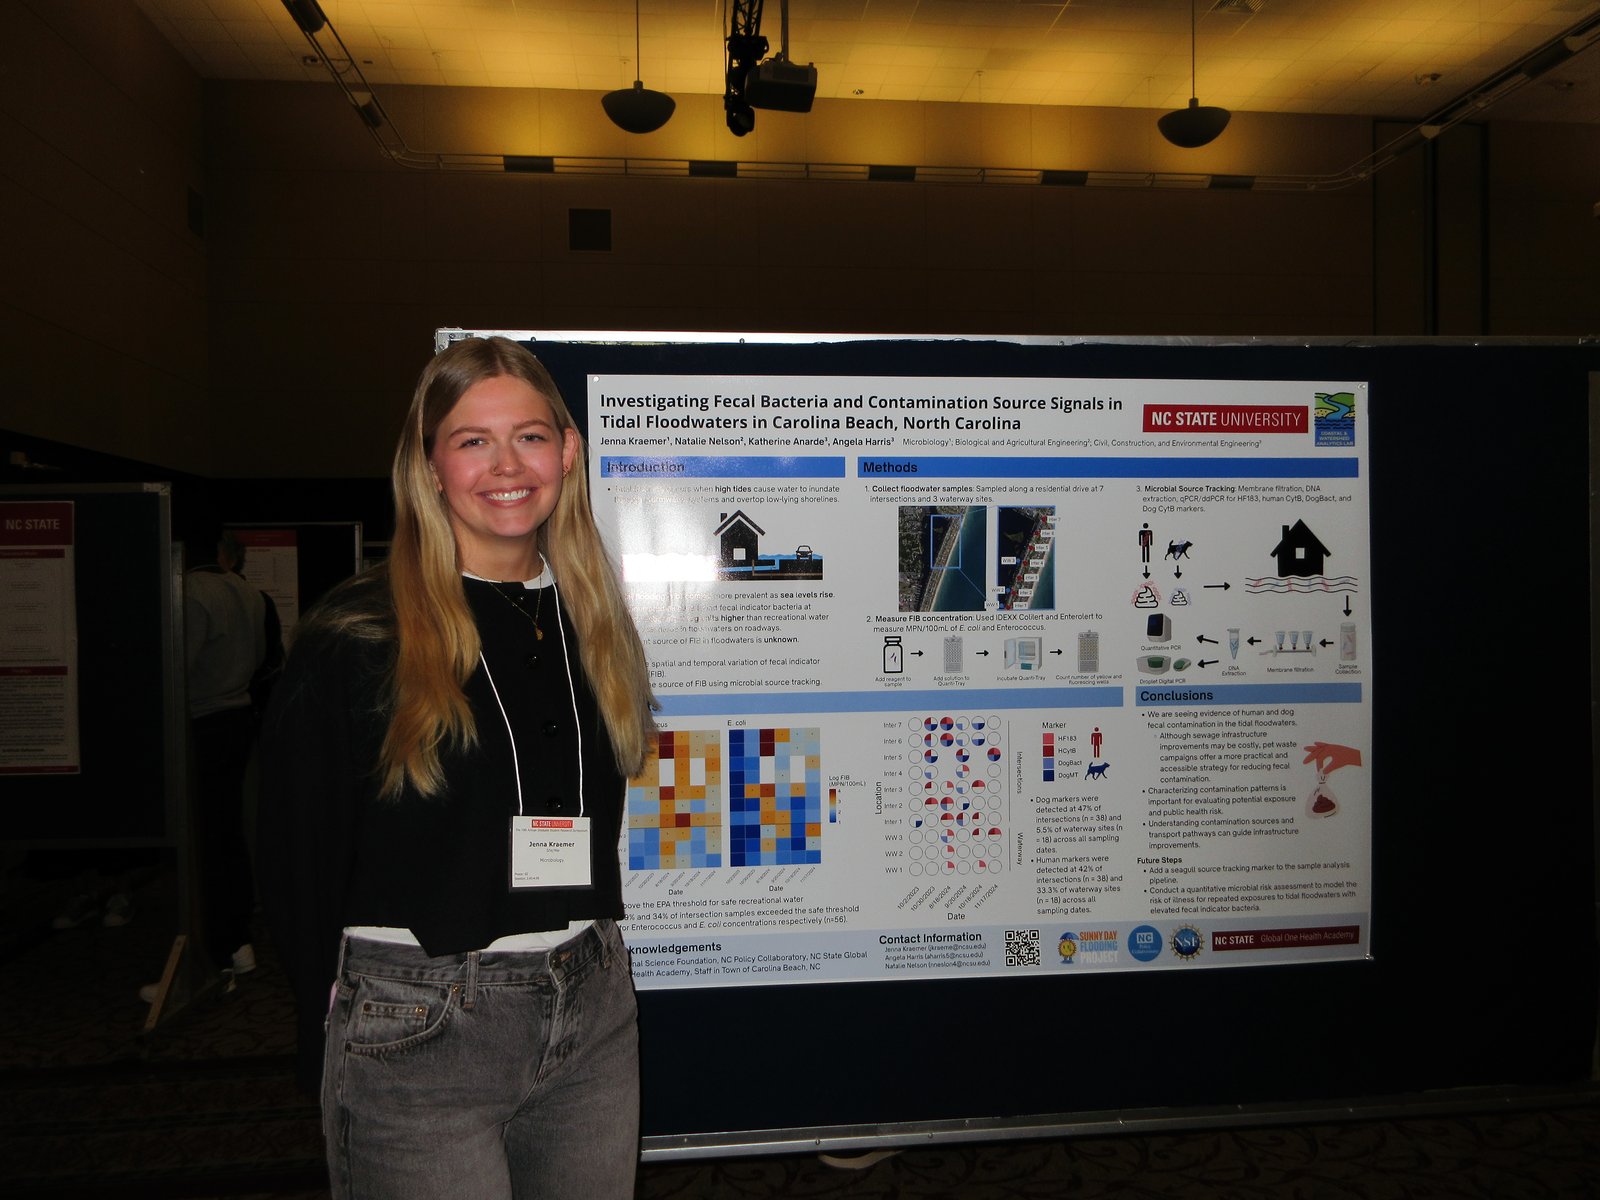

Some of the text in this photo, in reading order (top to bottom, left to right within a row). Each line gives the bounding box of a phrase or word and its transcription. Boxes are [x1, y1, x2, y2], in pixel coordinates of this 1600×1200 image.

[601, 394, 1122, 413] Investigating Fecal Bacteria and Contamination Source Signals in
[600, 415, 1020, 431] Tidal Floodwaters in Carolina Beach, North Carolina
[1152, 412, 1301, 426] NC STATE UNIVERSITY
[600, 437, 626, 445] Jenna
[675, 437, 706, 445] Natalie
[832, 438, 863, 447] Angela
[955, 439, 990, 447] Biological
[1006, 439, 1046, 447] Agricultural
[1111, 439, 1156, 447] Construction,
[605, 460, 686, 474] Introduction
[864, 462, 918, 472] Methods
[715, 485, 731, 494] high
[976, 485, 1007, 493] Sampled
[736, 496, 765, 504] overtop
[766, 496, 798, 504] low-lying
[940, 496, 974, 504] waterway
[1142, 505, 1157, 514] Dog
[1158, 505, 1175, 513] CytB
[6, 518, 60, 530] NC STATE
[734, 592, 768, 600] prevalent
[959, 624, 965, 632] E.
[1140, 690, 1214, 701] Conclusions
[1174, 710, 1198, 719] seeing
[1280, 709, 1294, 717] dog
[1036, 796, 1050, 805] Dog
[1162, 856, 1182, 864] Steps
[656, 900, 671, 908] EPA
[672, 900, 707, 908] threshold
[738, 897, 782, 905] recreational
[948, 912, 966, 920] Date
[879, 932, 982, 944] Contact Information
[1080, 931, 1118, 940] SUNNY DAY
[1215, 932, 1354, 944] NC STATE Global One Health Academy
[1080, 941, 1118, 952] FLOODING
[1174, 936, 1200, 948] NSF
[629, 942, 722, 955] knowledgements
[1080, 952, 1118, 963] PROJECT
